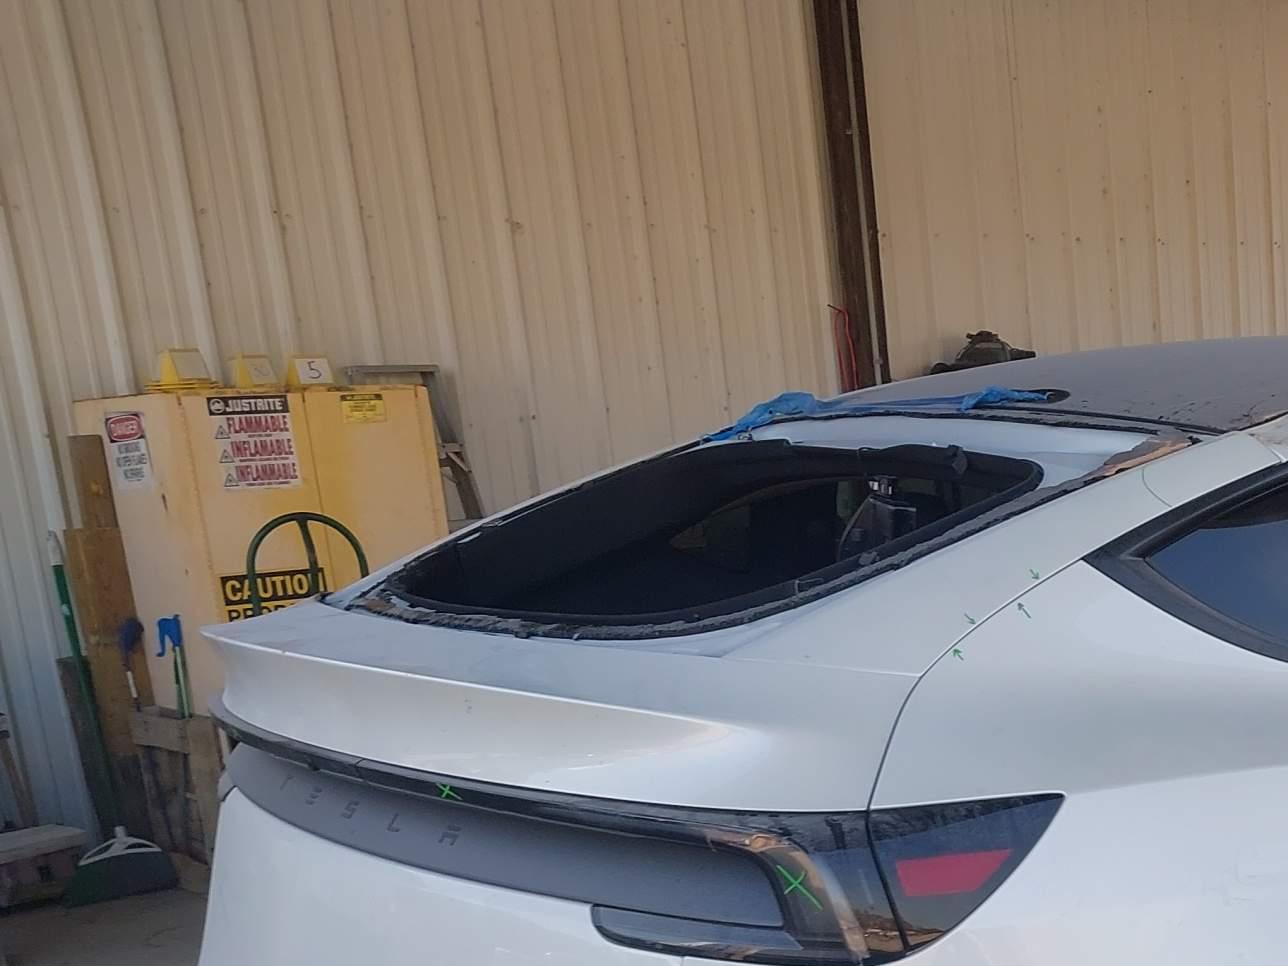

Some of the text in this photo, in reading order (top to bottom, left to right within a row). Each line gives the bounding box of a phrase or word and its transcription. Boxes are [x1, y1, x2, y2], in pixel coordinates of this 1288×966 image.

[307, 360, 322, 379] 5
[225, 398, 283, 412] JUSTRITE
[226, 415, 290, 434] FLAMMABLE
[230, 438, 294, 458] INFLAMABLE
[235, 462, 299, 482] INFLAMMABLE
[225, 572, 325, 601] CAUTION
[279, 775, 462, 846] TESLA
